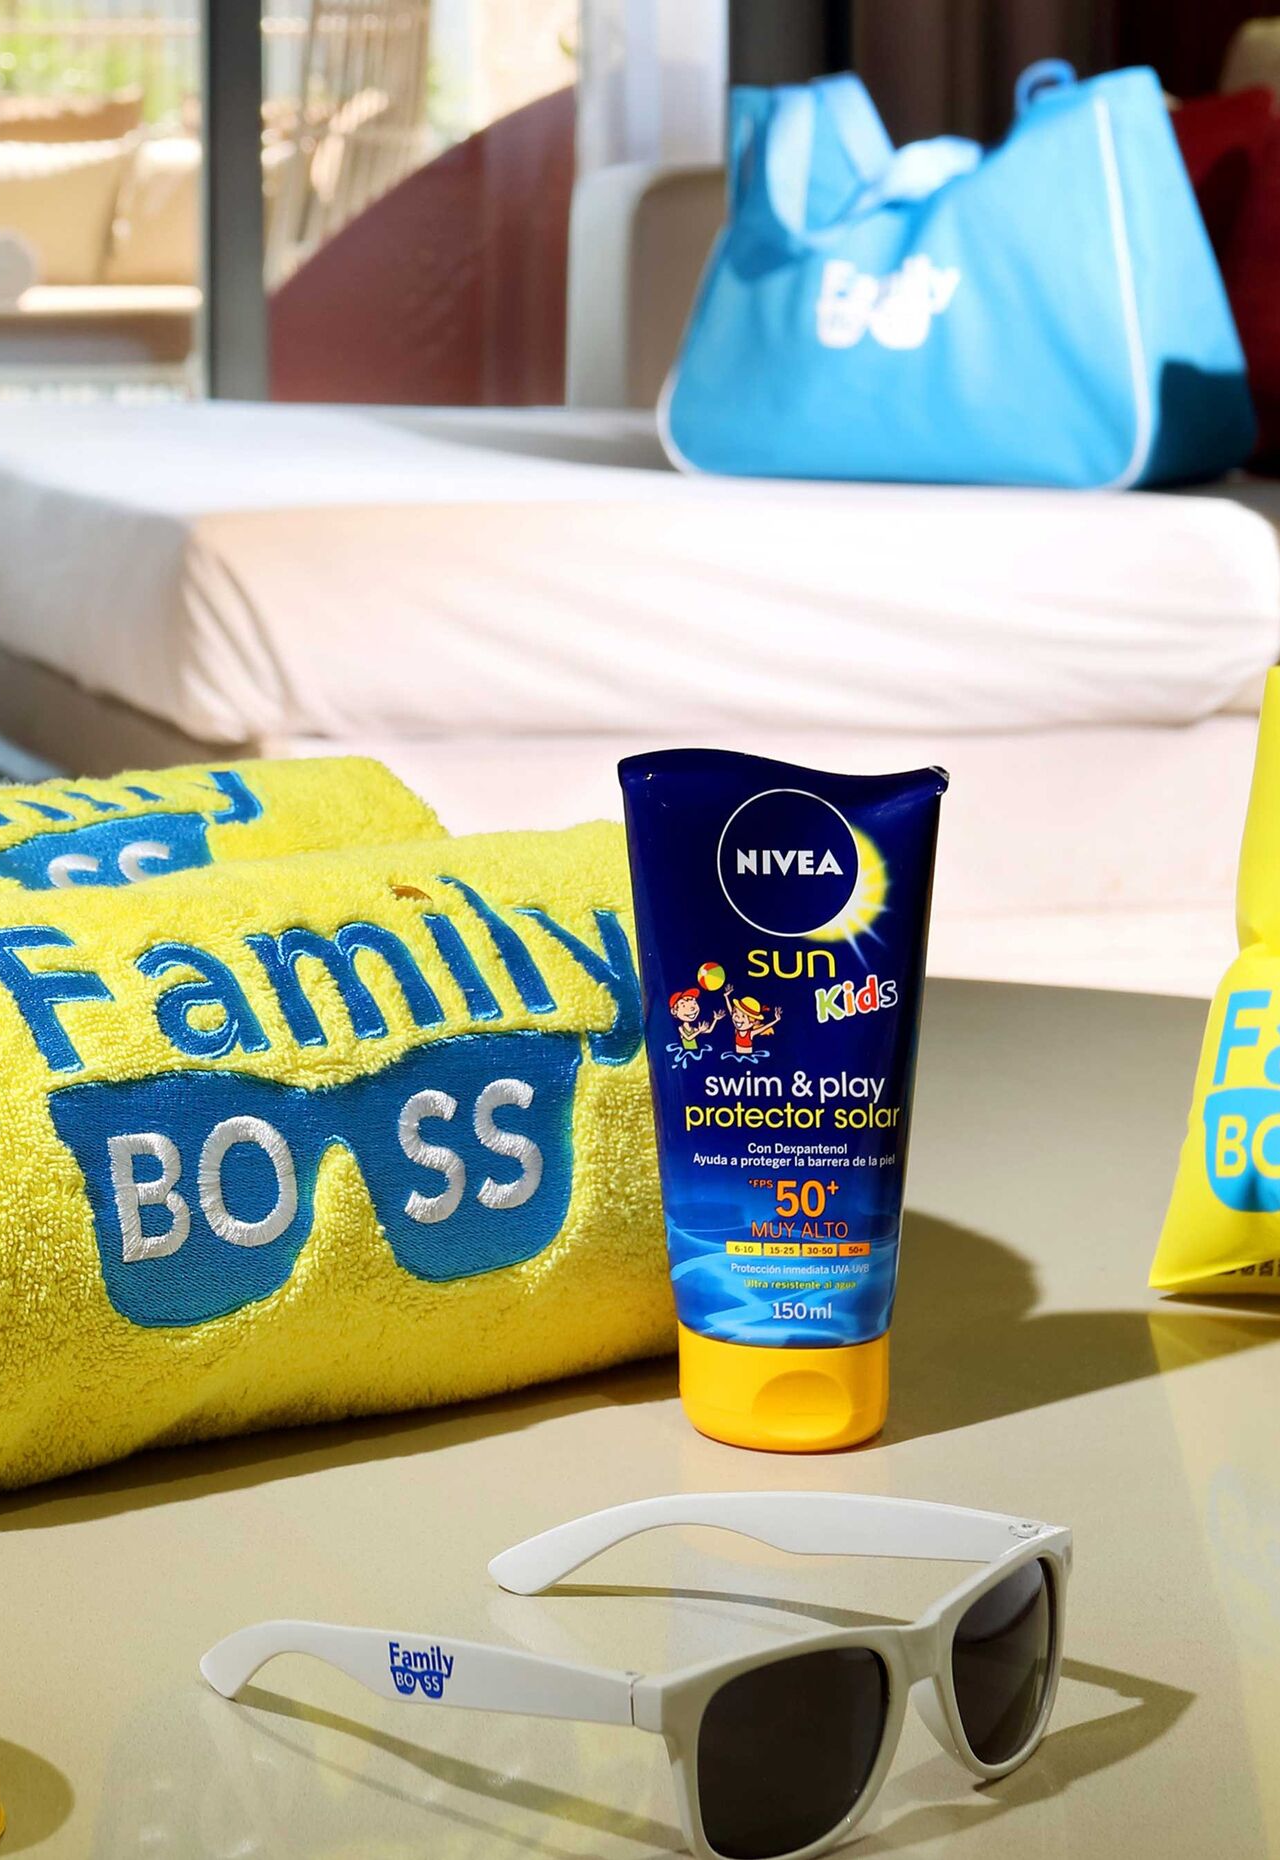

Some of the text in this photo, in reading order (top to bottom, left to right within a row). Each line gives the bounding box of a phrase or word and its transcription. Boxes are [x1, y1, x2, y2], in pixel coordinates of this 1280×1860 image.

[736, 848, 844, 876] NIVEA
[815, 974, 899, 1023] Kids
[705, 1071, 886, 1104] swim & play
[685, 1102, 901, 1131] protector solar
[693, 1153, 896, 1168] Ayuda a proteger la barrera de la piel
[747, 1143, 848, 1156] Con Dexpantenol
[776, 1179, 839, 1218] 50+
[751, 1221, 849, 1239] MUY ALTO
[730, 1262, 781, 1274] Protección
[772, 1302, 833, 1320] 150 ml
[388, 1641, 454, 1679] Family
